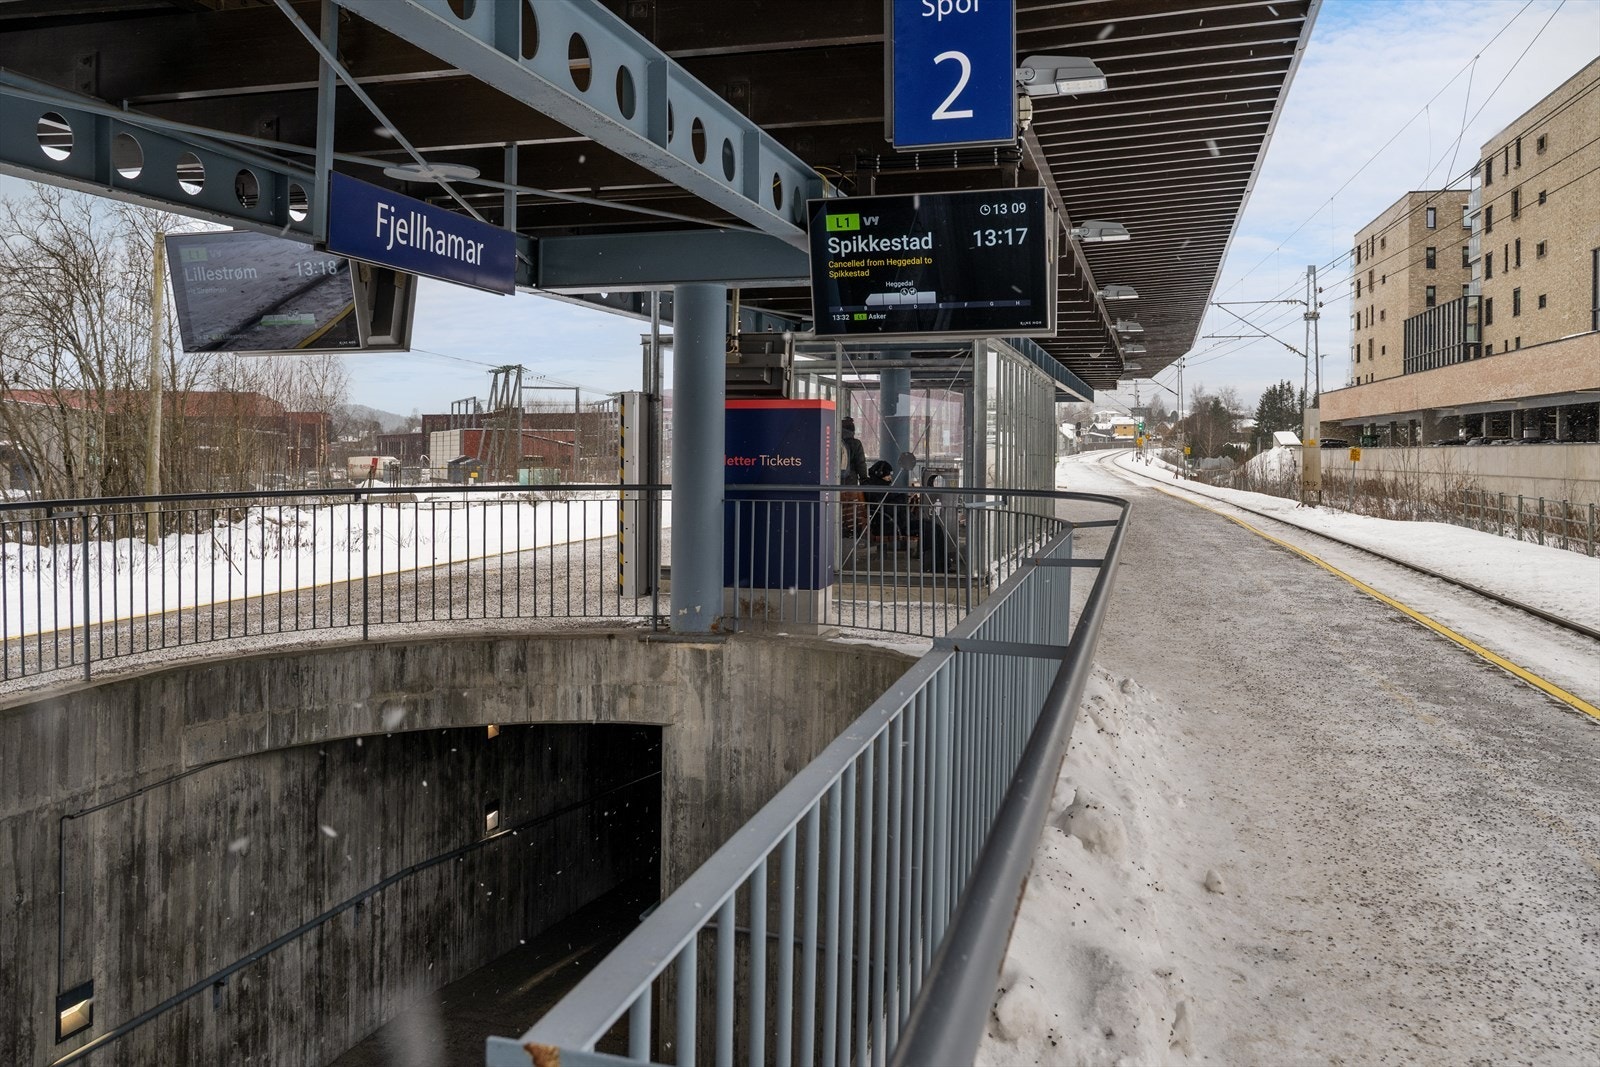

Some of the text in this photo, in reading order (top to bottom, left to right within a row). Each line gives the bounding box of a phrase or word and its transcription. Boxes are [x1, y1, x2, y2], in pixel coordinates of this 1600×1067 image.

[931, 50, 974, 121] 2
[993, 202, 1026, 215] 13 09
[836, 217, 850, 228] L1
[375, 201, 485, 266] Fjellhamar
[973, 227, 1028, 247] 13:17
[828, 231, 933, 258] Spikkestad
[294, 259, 338, 277] 13:18
[828, 257, 933, 268] Cancelled from Heggedal to
[184, 266, 258, 282] Lillestrøm
[828, 269, 870, 279] Spikkestad
[885, 280, 914, 288] Heggedal
[724, 454, 802, 466] letter Tickets
